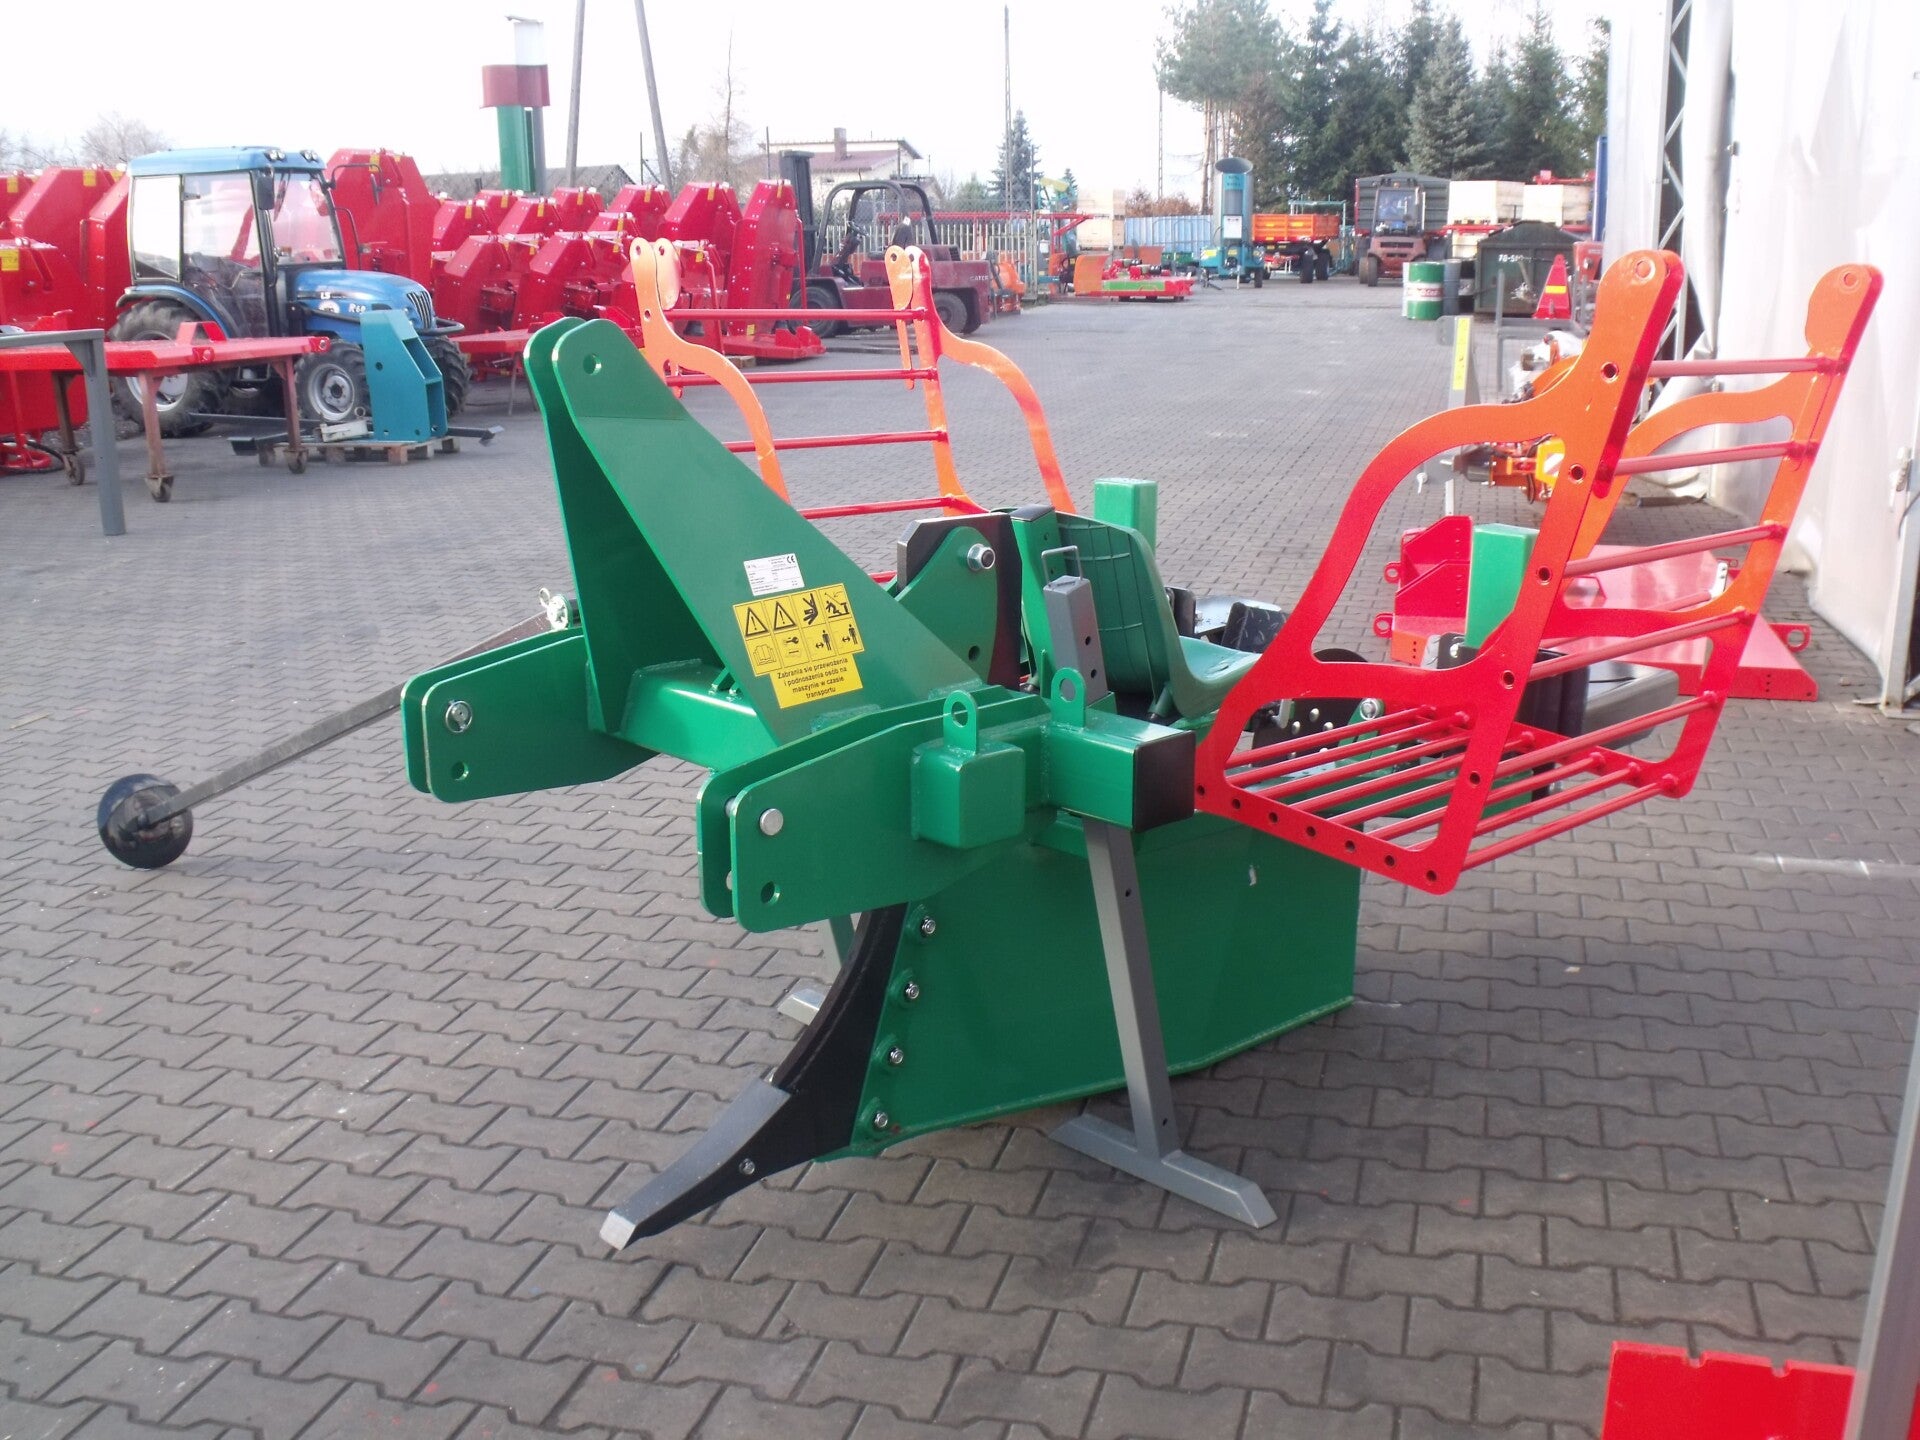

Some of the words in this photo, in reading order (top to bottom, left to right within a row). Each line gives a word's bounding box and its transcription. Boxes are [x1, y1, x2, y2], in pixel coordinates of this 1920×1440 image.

[320, 291, 331, 300] LS
[777, 668, 803, 679] Zabrania
[787, 672, 824, 687] podnoszenia
[792, 682, 820, 693] maszynie
[826, 676, 844, 685] czasie
[805, 687, 836, 698] transportu
